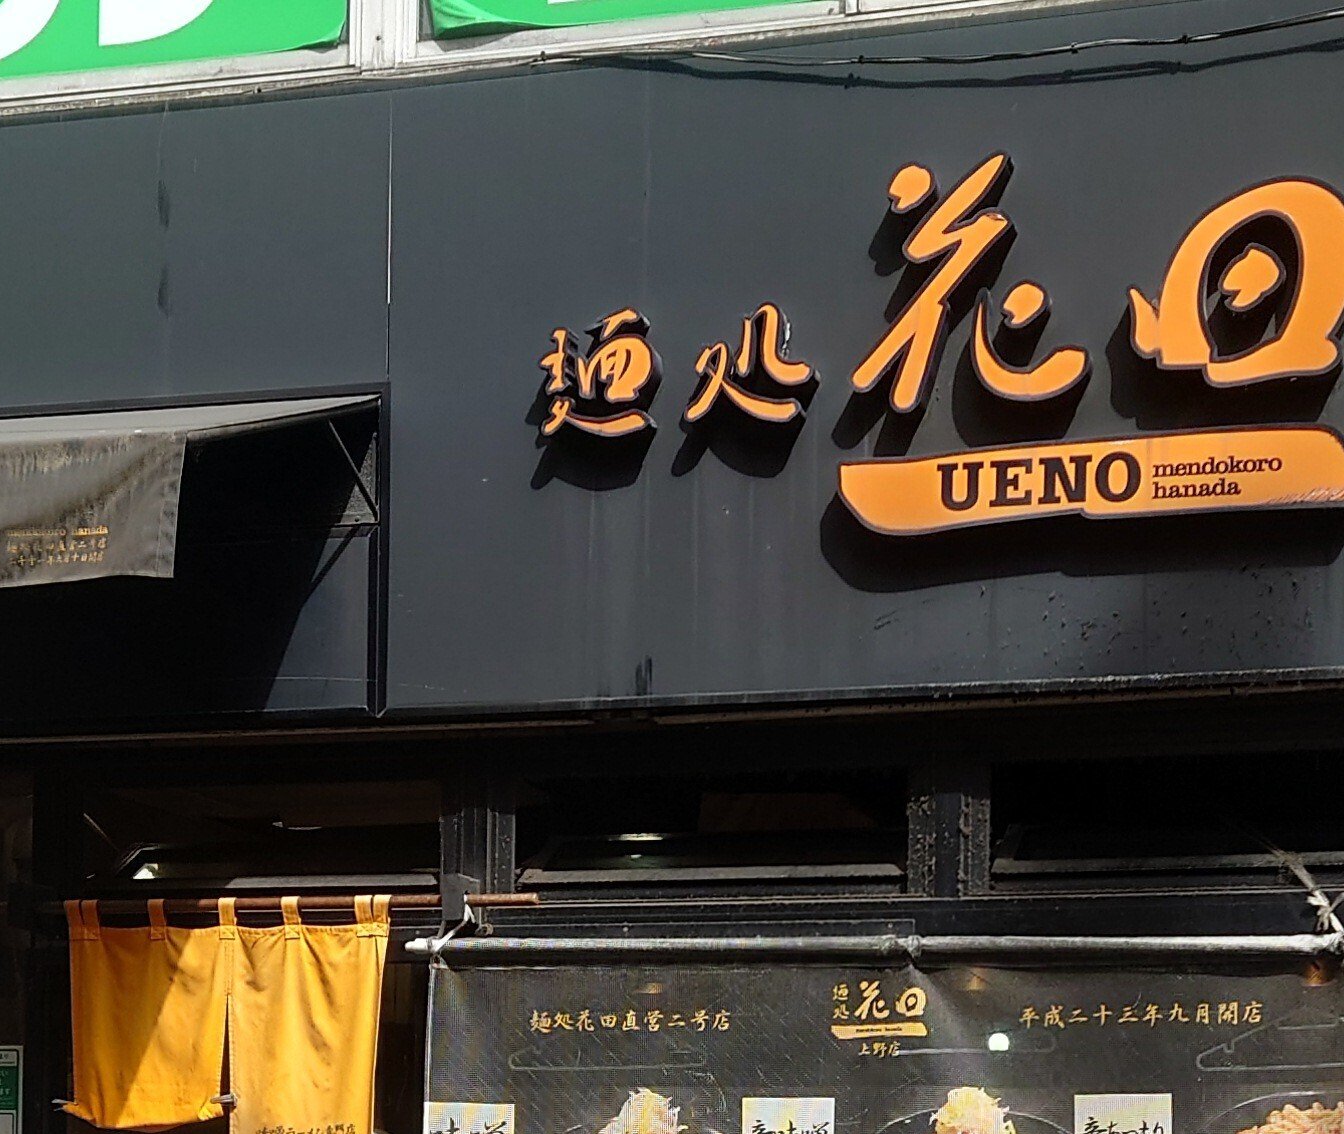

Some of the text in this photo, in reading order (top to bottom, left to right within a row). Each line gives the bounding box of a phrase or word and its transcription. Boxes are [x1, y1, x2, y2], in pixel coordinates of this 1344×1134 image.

[937, 452, 1143, 512] UENO
[1152, 454, 1284, 482] mendokoro
[1152, 474, 1242, 500] hanada
[529, 1008, 732, 1035] 麺処花田直営二号店
[1018, 1000, 1264, 1030] 平成二十三年九月開店
